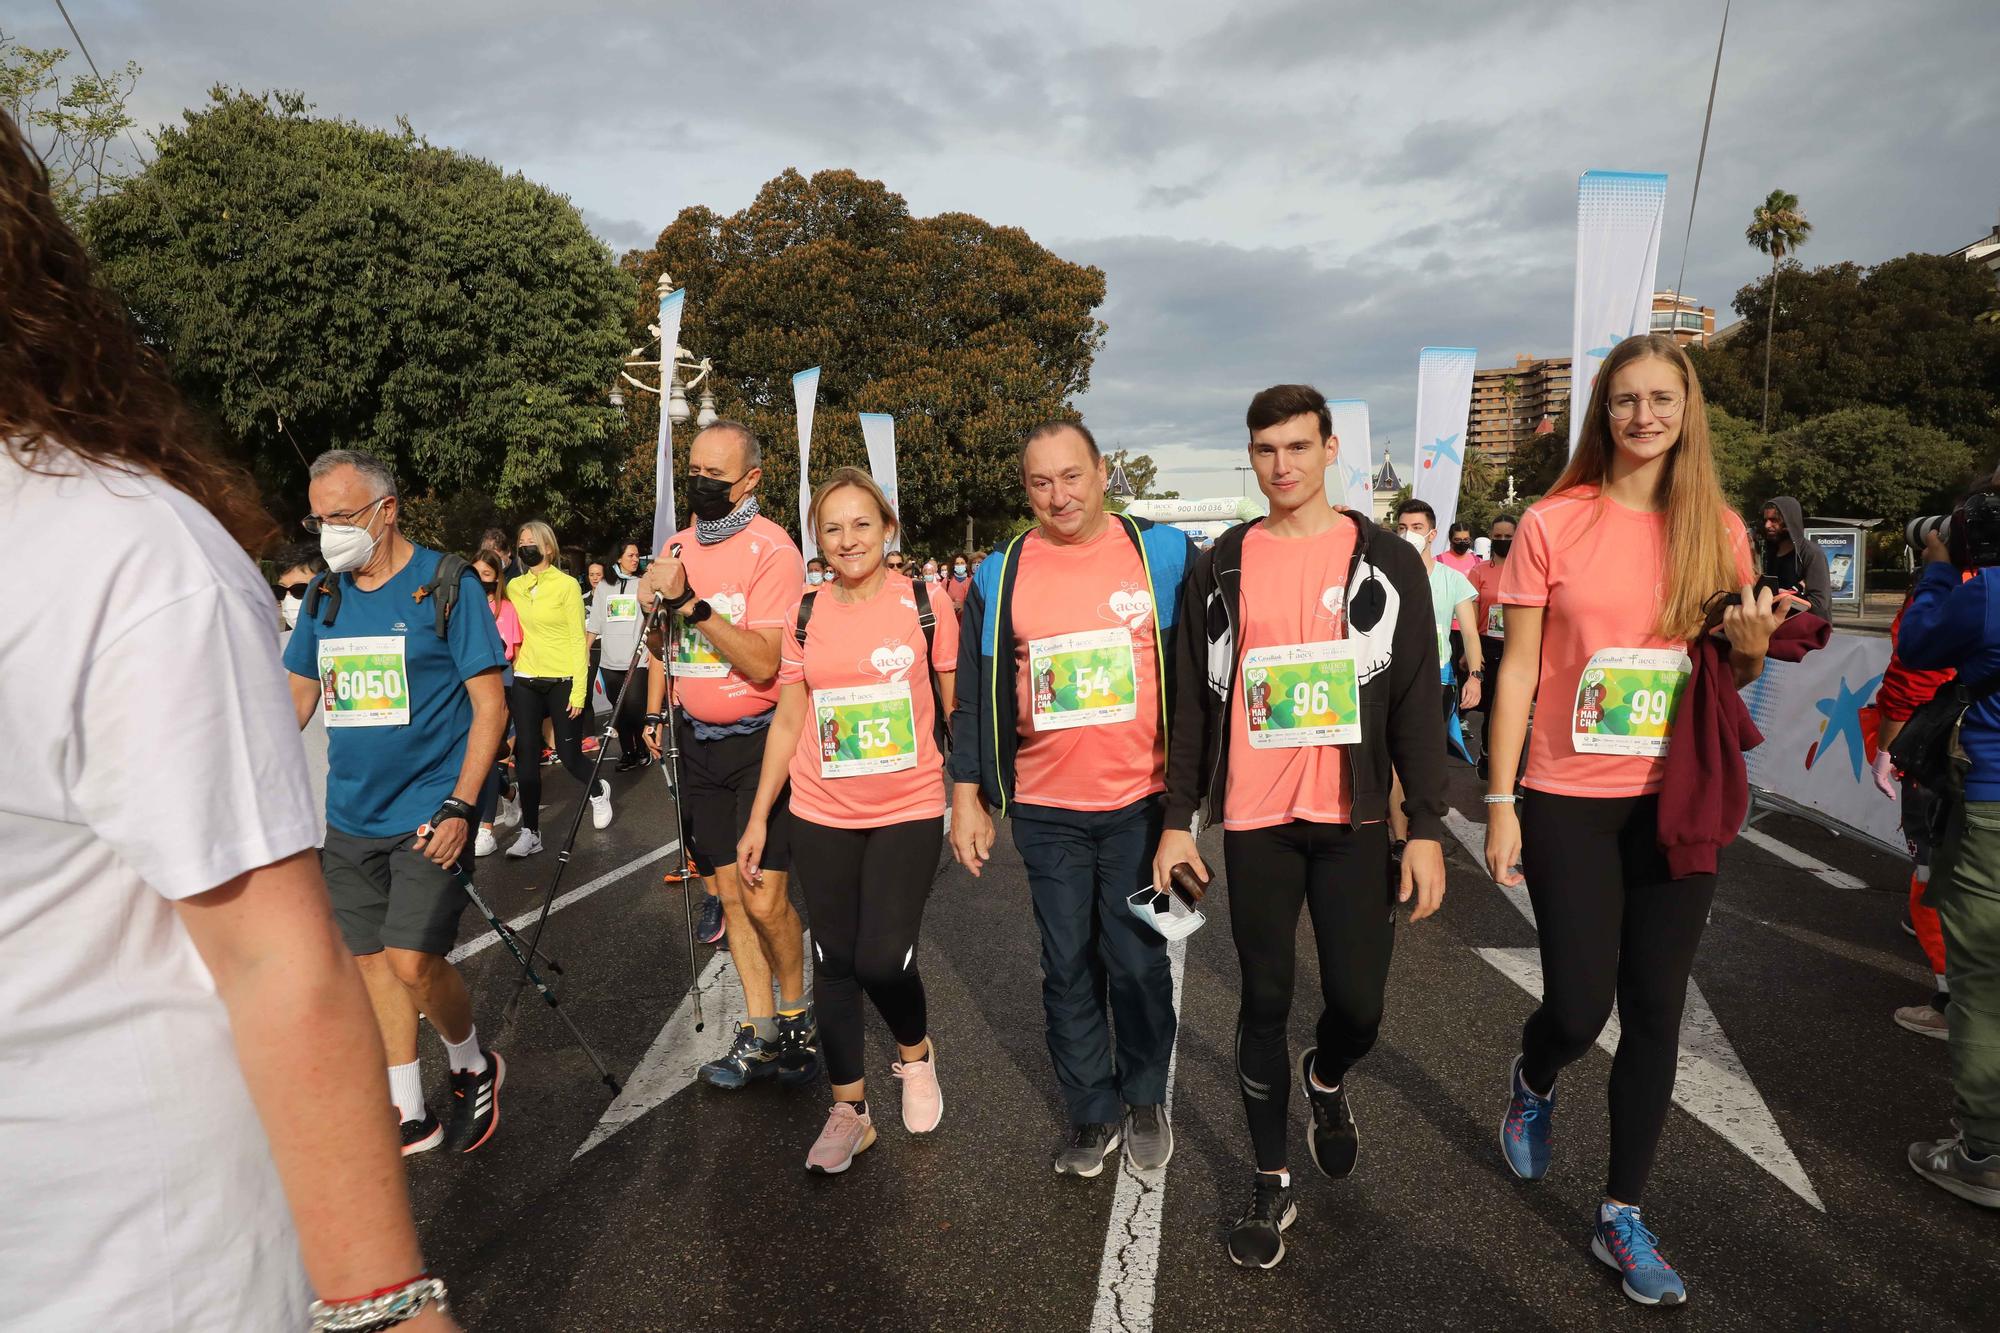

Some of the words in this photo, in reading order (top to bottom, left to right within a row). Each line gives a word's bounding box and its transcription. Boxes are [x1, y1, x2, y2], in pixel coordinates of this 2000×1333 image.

[1193, 504, 1207, 512] 100
[1208, 503, 1222, 511] 036
[1116, 602, 1150, 612] aecc
[681, 627, 714, 654] 475
[876, 656, 912, 667] aecc
[337, 669, 402, 700] 6050
[1076, 665, 1111, 699] 54
[1037, 693, 1052, 701] MAR
[1293, 680, 1329, 717] 96
[1251, 708, 1267, 717] MAR
[1629, 689, 1667, 725] 99
[1580, 710, 1598, 719] MAR
[1252, 716, 1267, 725] CHA
[1580, 719, 1597, 728] CHA
[858, 717, 890, 749] 53
[1933, 1155, 1948, 1170] N
